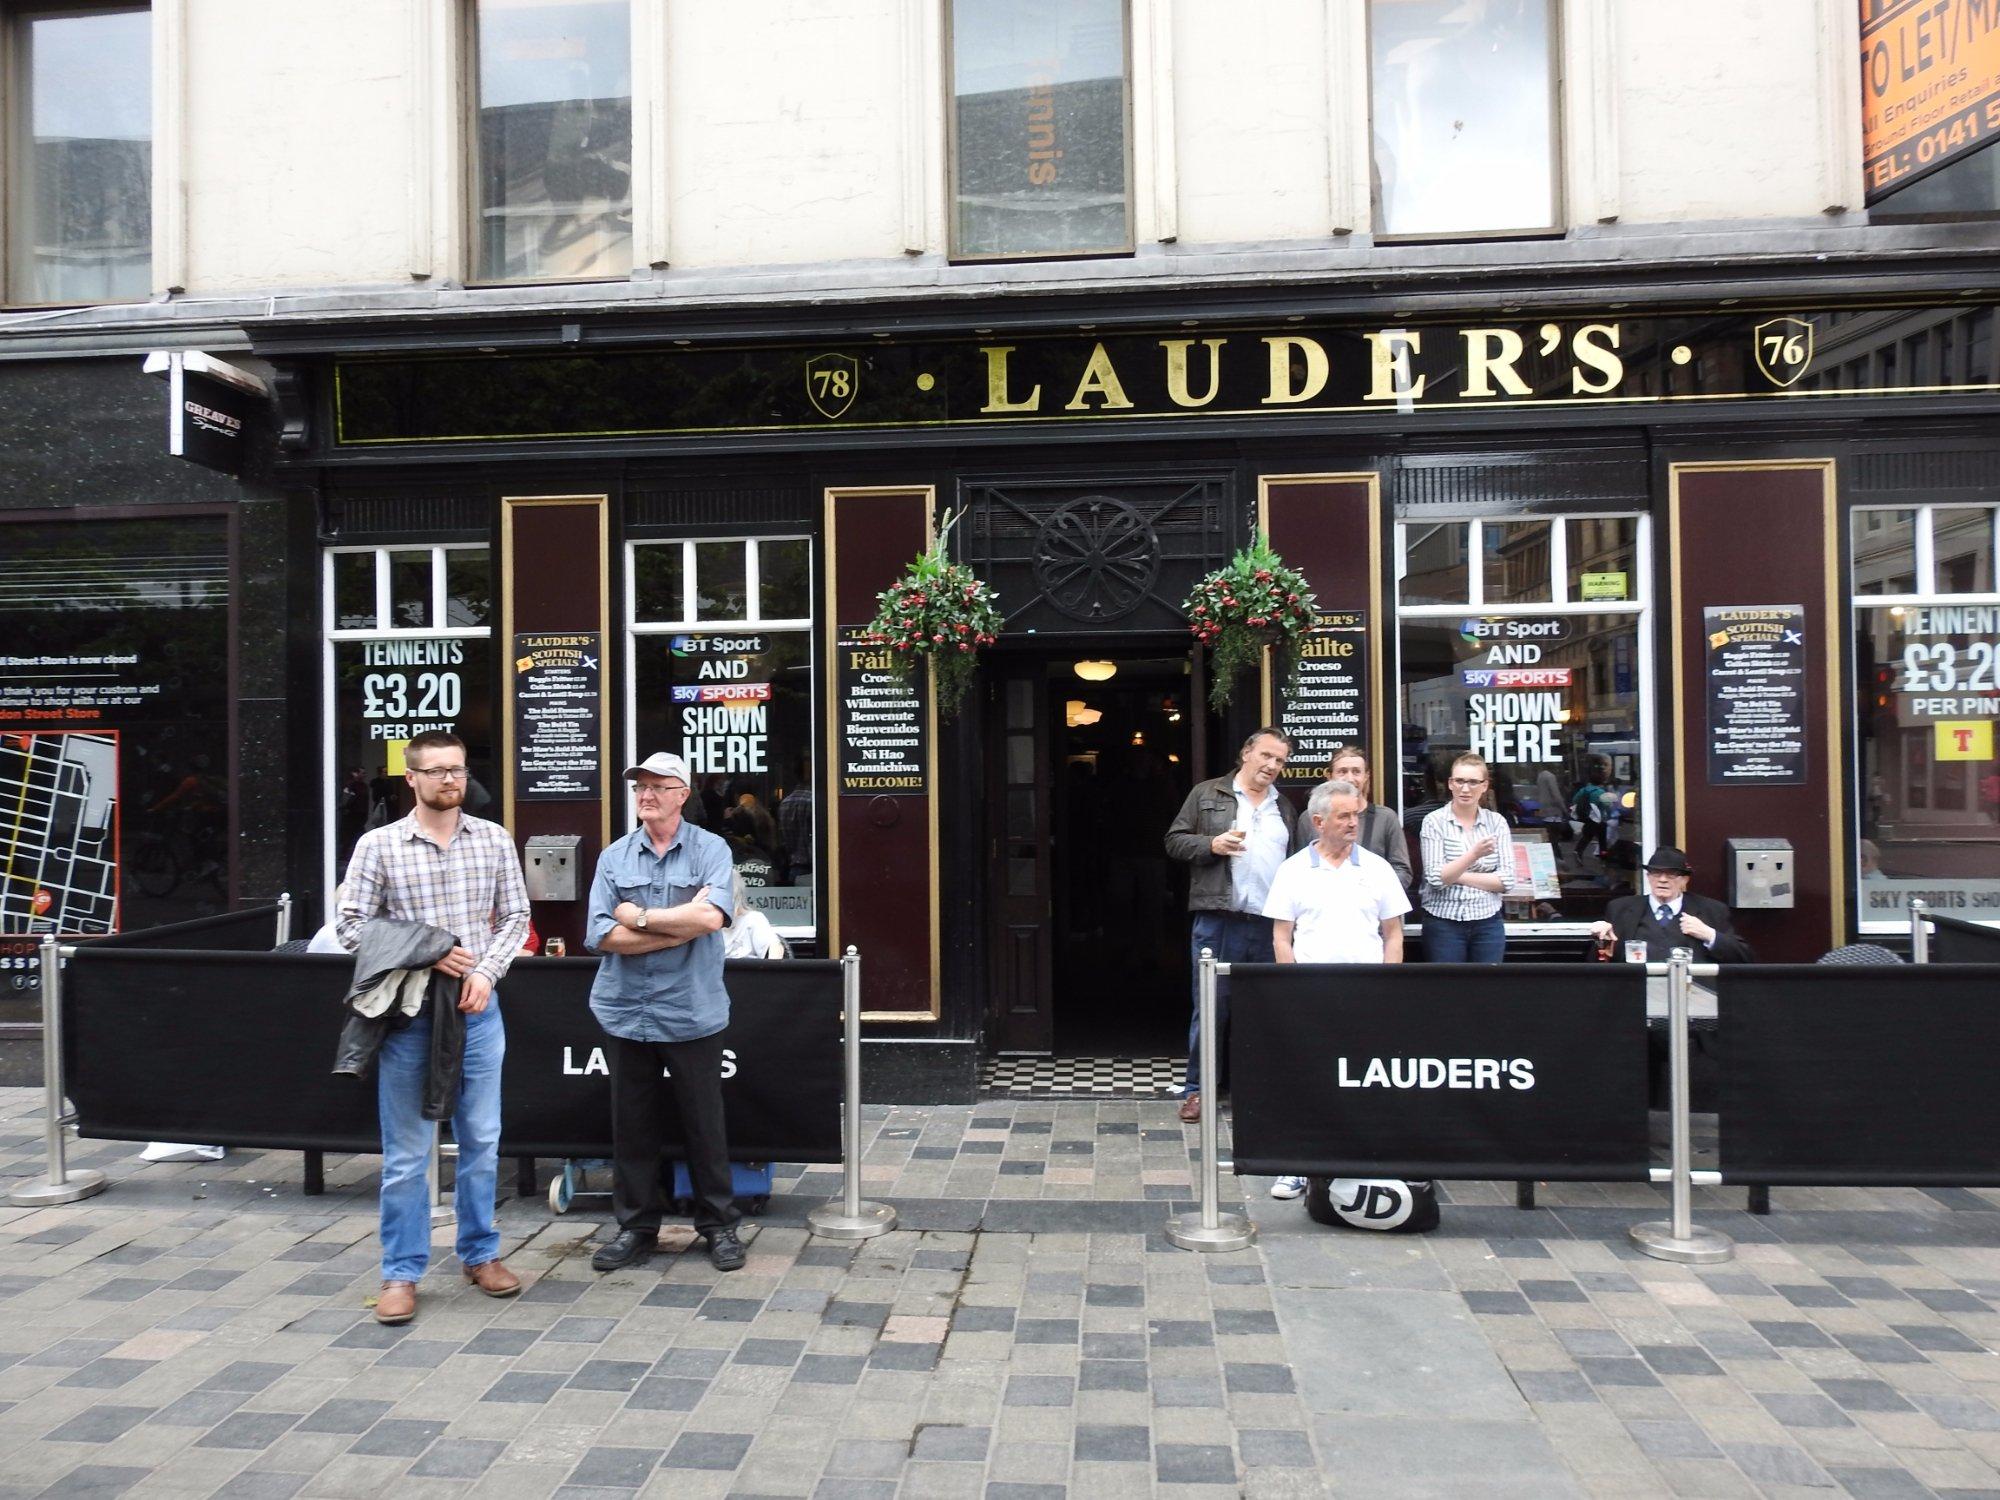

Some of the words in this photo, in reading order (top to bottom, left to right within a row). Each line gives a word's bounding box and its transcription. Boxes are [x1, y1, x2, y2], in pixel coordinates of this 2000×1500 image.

[1885, 67, 1967, 124] Enquiries
[1911, 105, 1945, 127] Floor
[1950, 78, 1990, 106] Retail
[1917, 111, 1978, 163] 0141
[1762, 334, 1804, 366] 76
[979, 323, 1624, 412] LAUDER'S
[813, 370, 849, 399] 78
[185, 400, 241, 430] GREAVES
[1720, 610, 1792, 620] LAUDER'S
[1474, 623, 1505, 636] BT
[1507, 621, 1560, 638] Sport
[1726, 622, 1784, 634] SCOTTISH
[527, 637, 590, 647] LAUDER'S
[1730, 632, 1780, 642] SPECIALS
[361, 639, 464, 666] TENNENTS
[682, 639, 711, 652] BT
[713, 637, 761, 654] Sport
[1301, 638, 1354, 657] àilte
[8, 657, 39, 666] Street
[40, 657, 68, 665] Store
[69, 656, 79, 665] is
[79, 657, 102, 665] now
[103, 654, 138, 664] closed
[532, 649, 583, 660] SCOTTISH
[1486, 645, 1541, 664] AND
[535, 658, 579, 668] SPECIALS
[698, 660, 749, 679] AND
[1298, 661, 1342, 671] Croeso
[1904, 643, 2000, 692] £3.2
[1466, 671, 1492, 686] sky
[1497, 671, 1568, 684] SPORTS
[3, 686, 33, 695] thank
[34, 687, 55, 697] you
[56, 686, 72, 695] for
[73, 687, 98, 697] your
[100, 685, 138, 694] custom
[139, 684, 160, 694] and
[363, 672, 461, 718] £3.20
[674, 686, 699, 701] sky
[703, 686, 768, 700] SPORTS
[851, 686, 914, 696] Bienvene
[30, 698, 42, 706] to
[1469, 693, 1561, 723] SHOWN
[1913, 698, 1958, 715] PER
[1963, 698, 2000, 715] PIN
[24, 709, 64, 720] Street
[65, 708, 101, 719] Store
[682, 706, 767, 734] SHOWN
[851, 712, 915, 721] Benvenute
[1282, 712, 1360, 723] Bienvenidos
[370, 723, 409, 739] PER
[846, 723, 920, 734] Bienvenidos
[1282, 726, 1359, 737] Velcommen
[847, 737, 919, 747] Velcommen
[1298, 739, 1313, 749] Ni
[1316, 739, 1343, 749] Hao
[1470, 723, 1563, 763] HERE
[1953, 730, 1973, 751] T
[683, 735, 768, 773] HERE
[862, 749, 877, 759] Ni
[879, 750, 905, 759] Hao
[847, 761, 920, 772] Konnichiwa
[844, 777, 923, 788] WELCOME!
[756, 896, 808, 910] SATURDAY
[1870, 891, 1901, 908] SKY
[1907, 891, 1966, 908] SPORTS
[1338, 1057, 1535, 1090] LAUDER'S
[1340, 1184, 1402, 1219] JD
